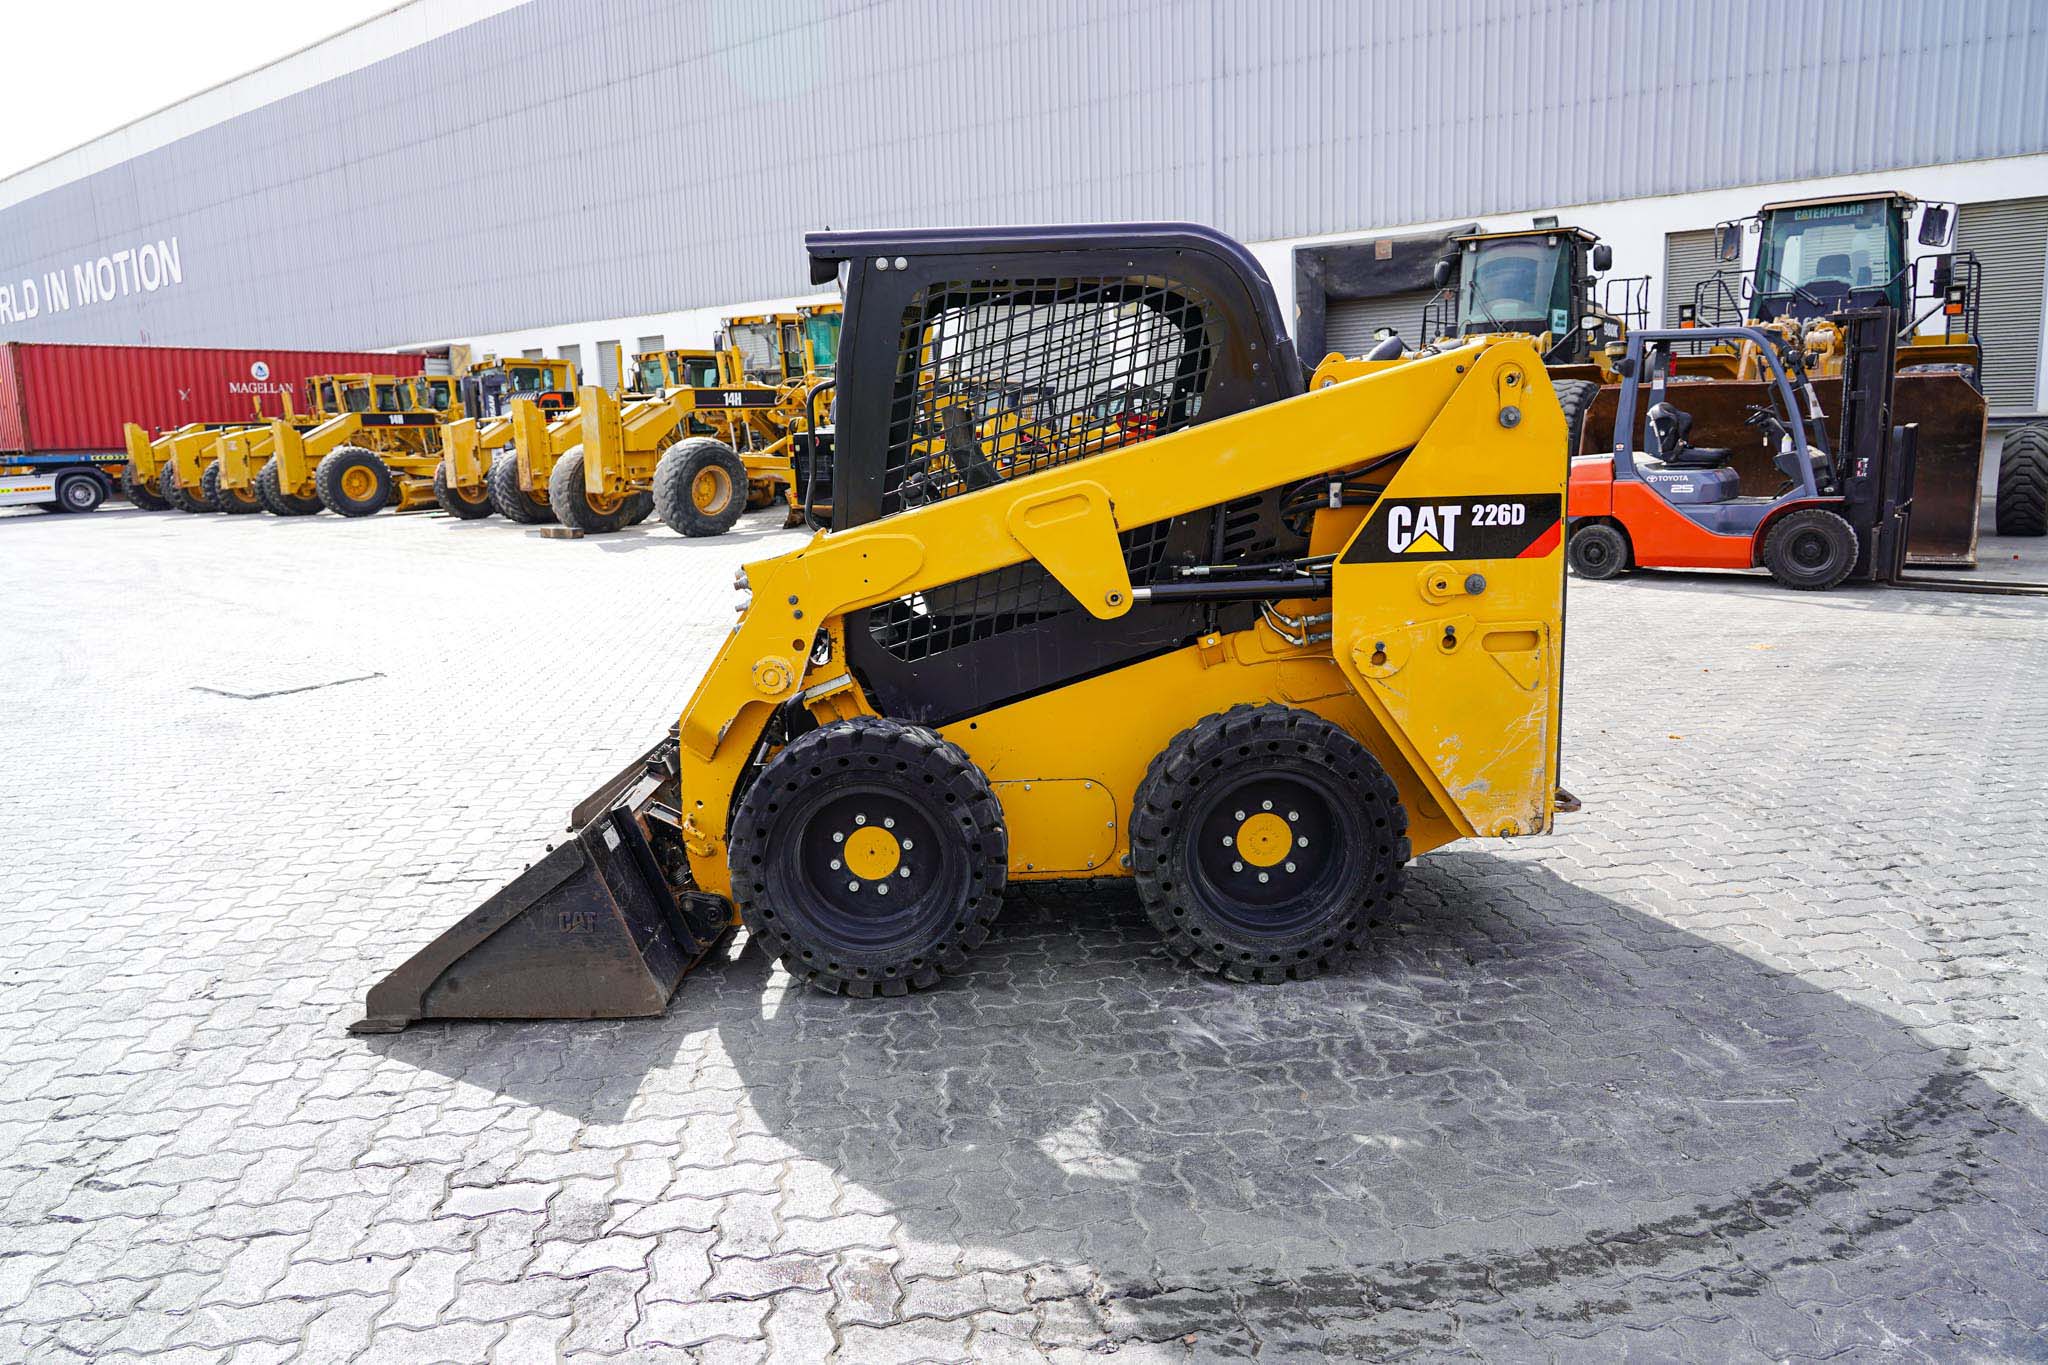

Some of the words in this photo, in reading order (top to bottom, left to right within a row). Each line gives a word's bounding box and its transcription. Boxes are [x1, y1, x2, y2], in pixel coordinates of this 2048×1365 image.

[1794, 204, 1864, 221] CATERPILLAR
[43, 269, 70, 314] IN
[73, 236, 183, 307] MOTION
[229, 382, 294, 394] MAGELLAN
[723, 392, 742, 407] 14H
[1658, 474, 1689, 482] TOYOTA
[1670, 484, 1694, 493] 25
[1388, 505, 1462, 554] CAT
[1471, 503, 1526, 527] 226D
[559, 911, 597, 934] CAT
